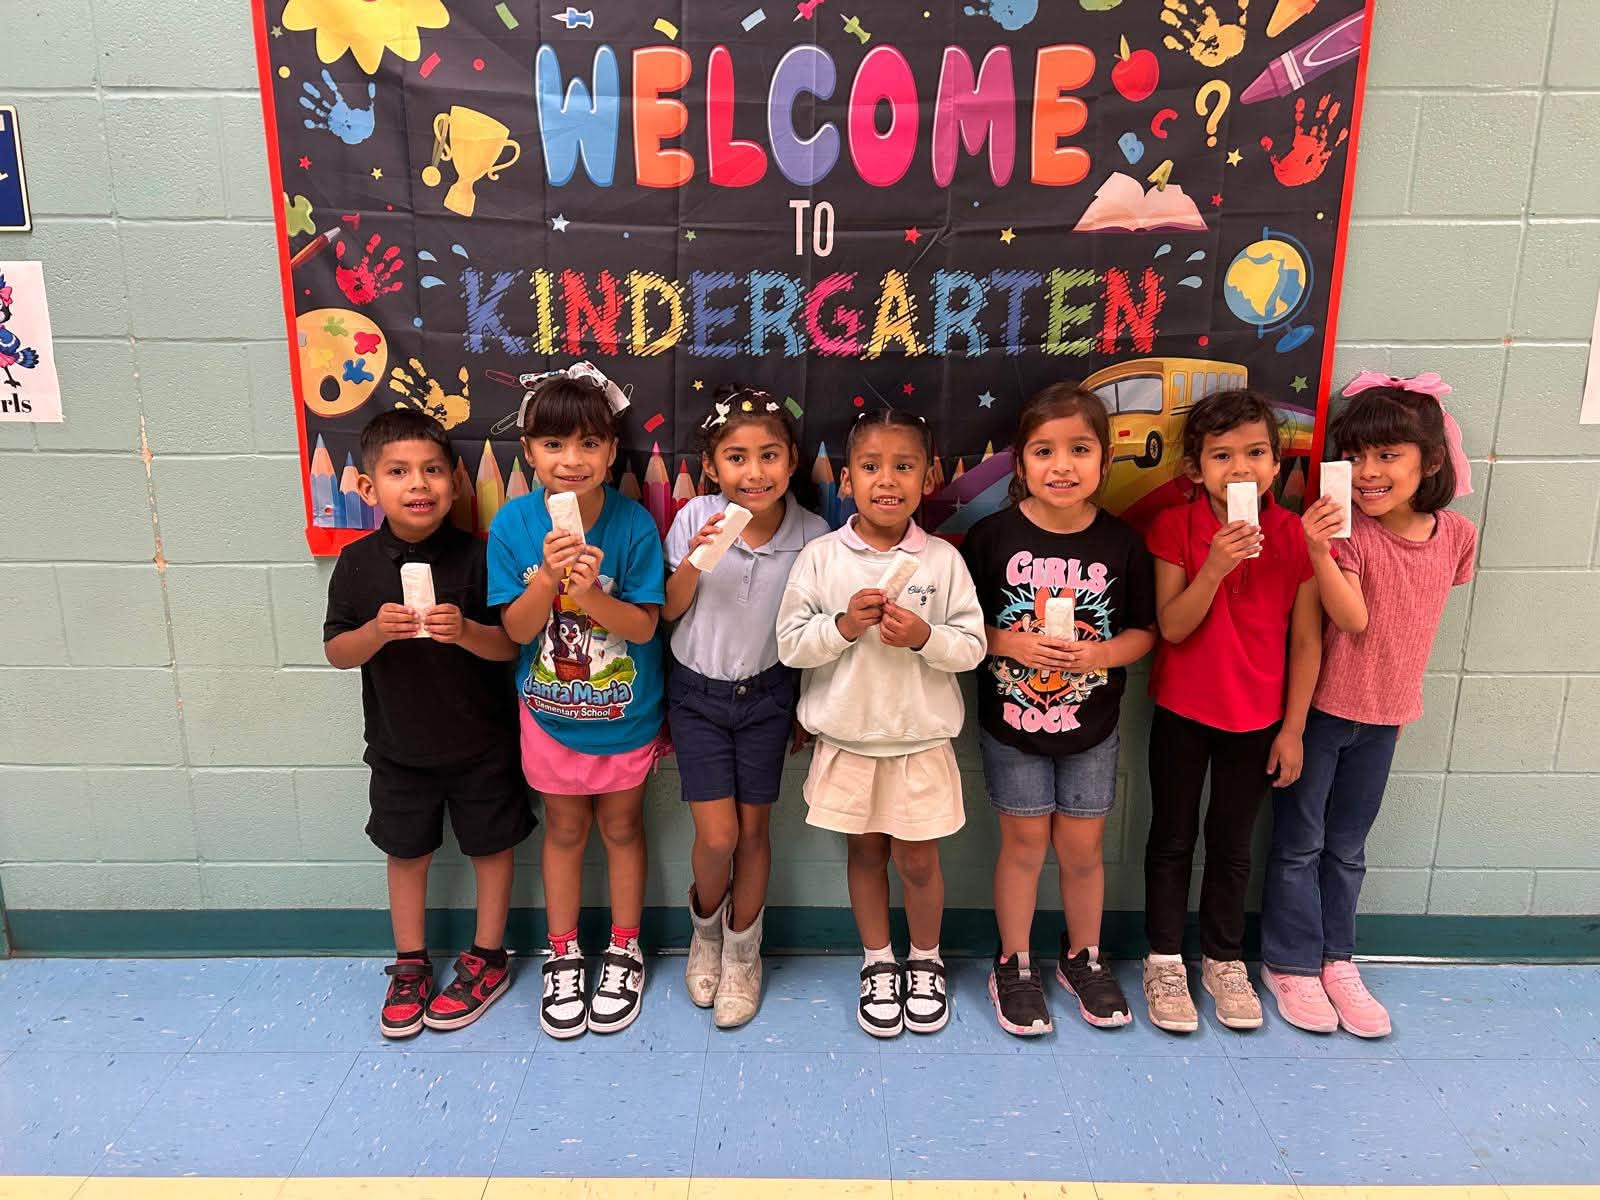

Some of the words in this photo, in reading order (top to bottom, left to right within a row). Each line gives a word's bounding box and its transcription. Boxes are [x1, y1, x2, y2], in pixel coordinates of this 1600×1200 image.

[535, 43, 1097, 188] WELCOME
[789, 199, 835, 257] TO
[463, 267, 1166, 361] KINDERGARTEN
[1006, 550, 1108, 594] GIRLS
[572, 680, 632, 706] Maria
[581, 707, 610, 717] School
[1003, 702, 1081, 734] ROCK
